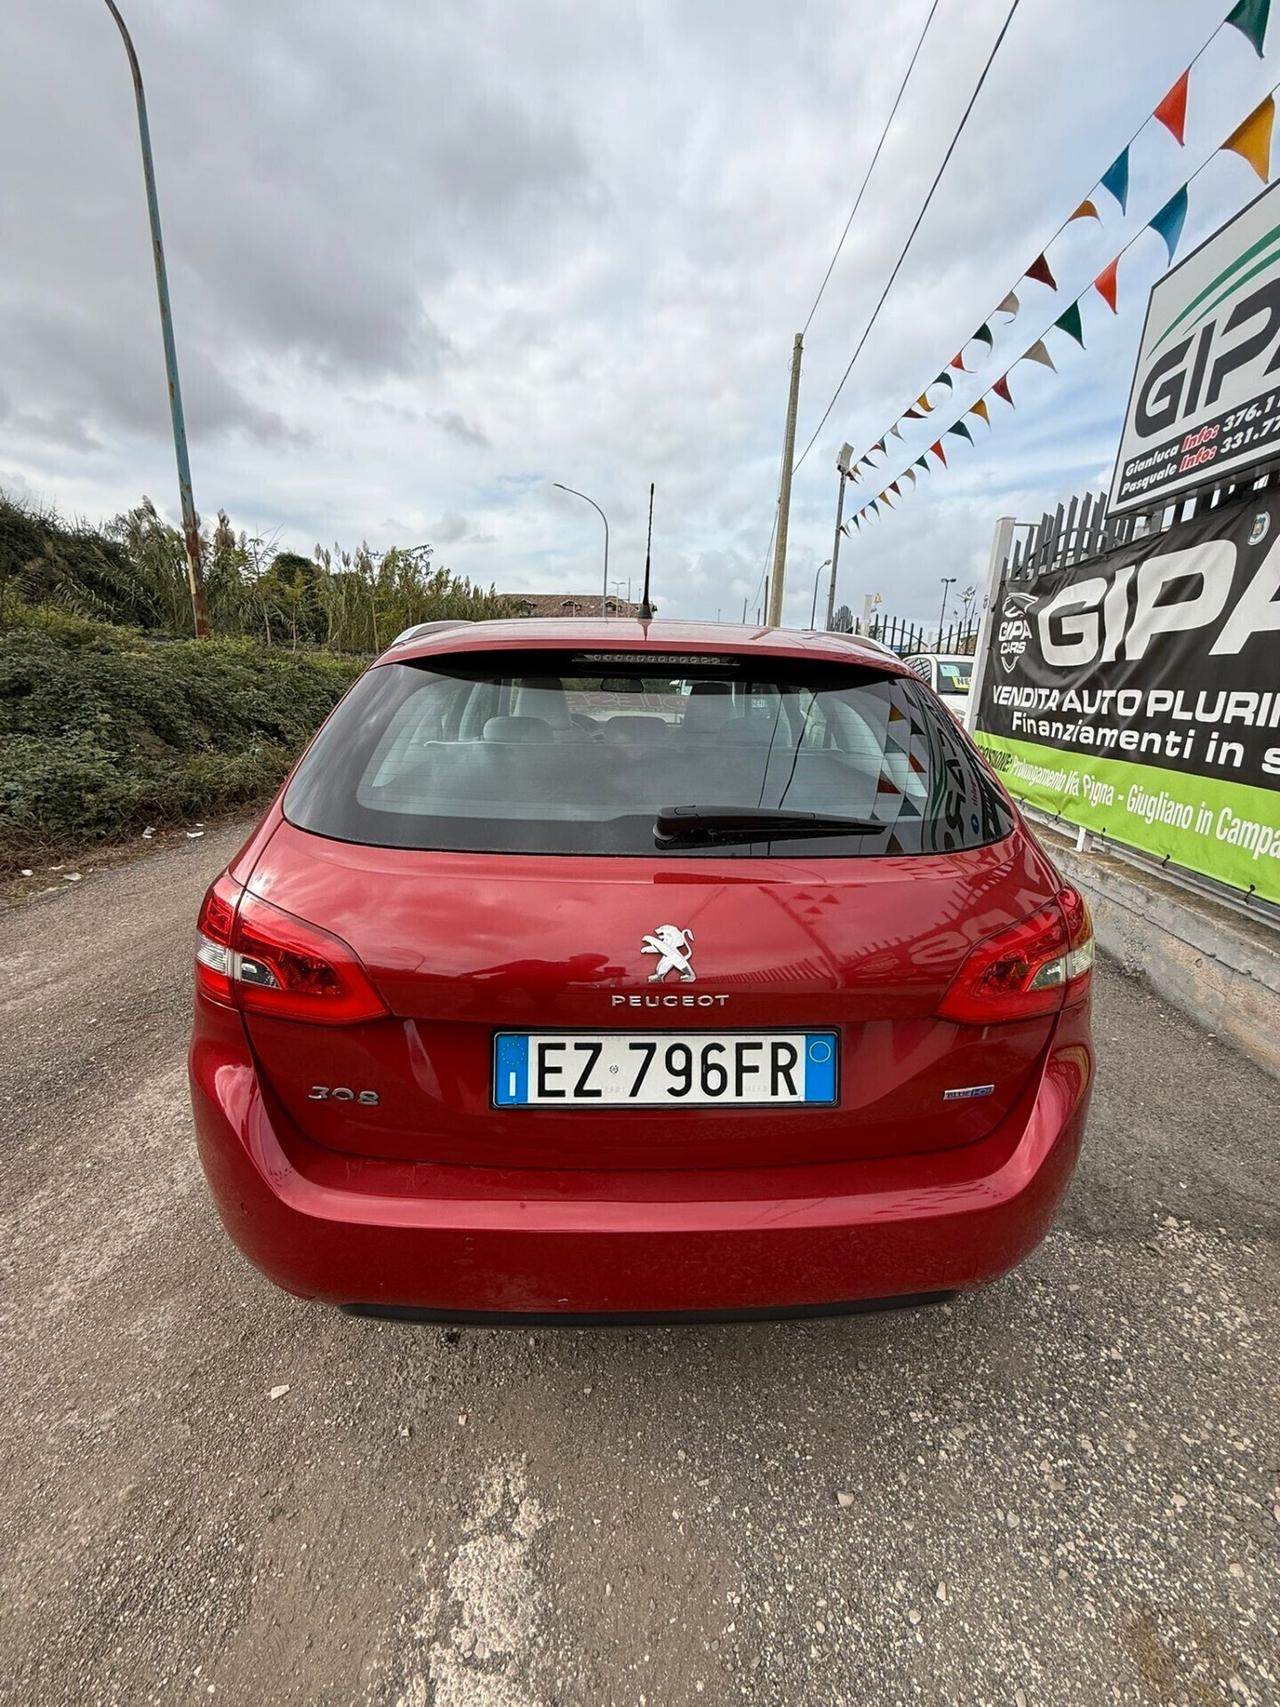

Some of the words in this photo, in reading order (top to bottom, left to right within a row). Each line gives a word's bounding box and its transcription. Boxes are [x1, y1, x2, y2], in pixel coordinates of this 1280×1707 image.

[1135, 277, 1280, 438] GIP
[1121, 464, 1177, 496] Pasquale
[1178, 445, 1217, 473] Info:
[1125, 444, 1179, 477] Gianluca
[1181, 424, 1220, 453] Info:
[999, 620, 1032, 641] GIPA
[1000, 642, 1026, 655] CARS
[993, 685, 1059, 711] VENDITA
[1062, 689, 1142, 717] AUTO
[1012, 711, 1195, 759] Finanziamenti
[1205, 732, 1244, 768] in
[1063, 769, 1079, 797] Via
[1082, 774, 1114, 807] Pigna
[1126, 784, 1193, 830] Giugliano
[1194, 801, 1213, 836] in
[611, 995, 729, 1007] PEUGEOT
[537, 1042, 603, 1097] EZ
[628, 1042, 798, 1097] 796FR
[308, 1086, 379, 1106] 308
